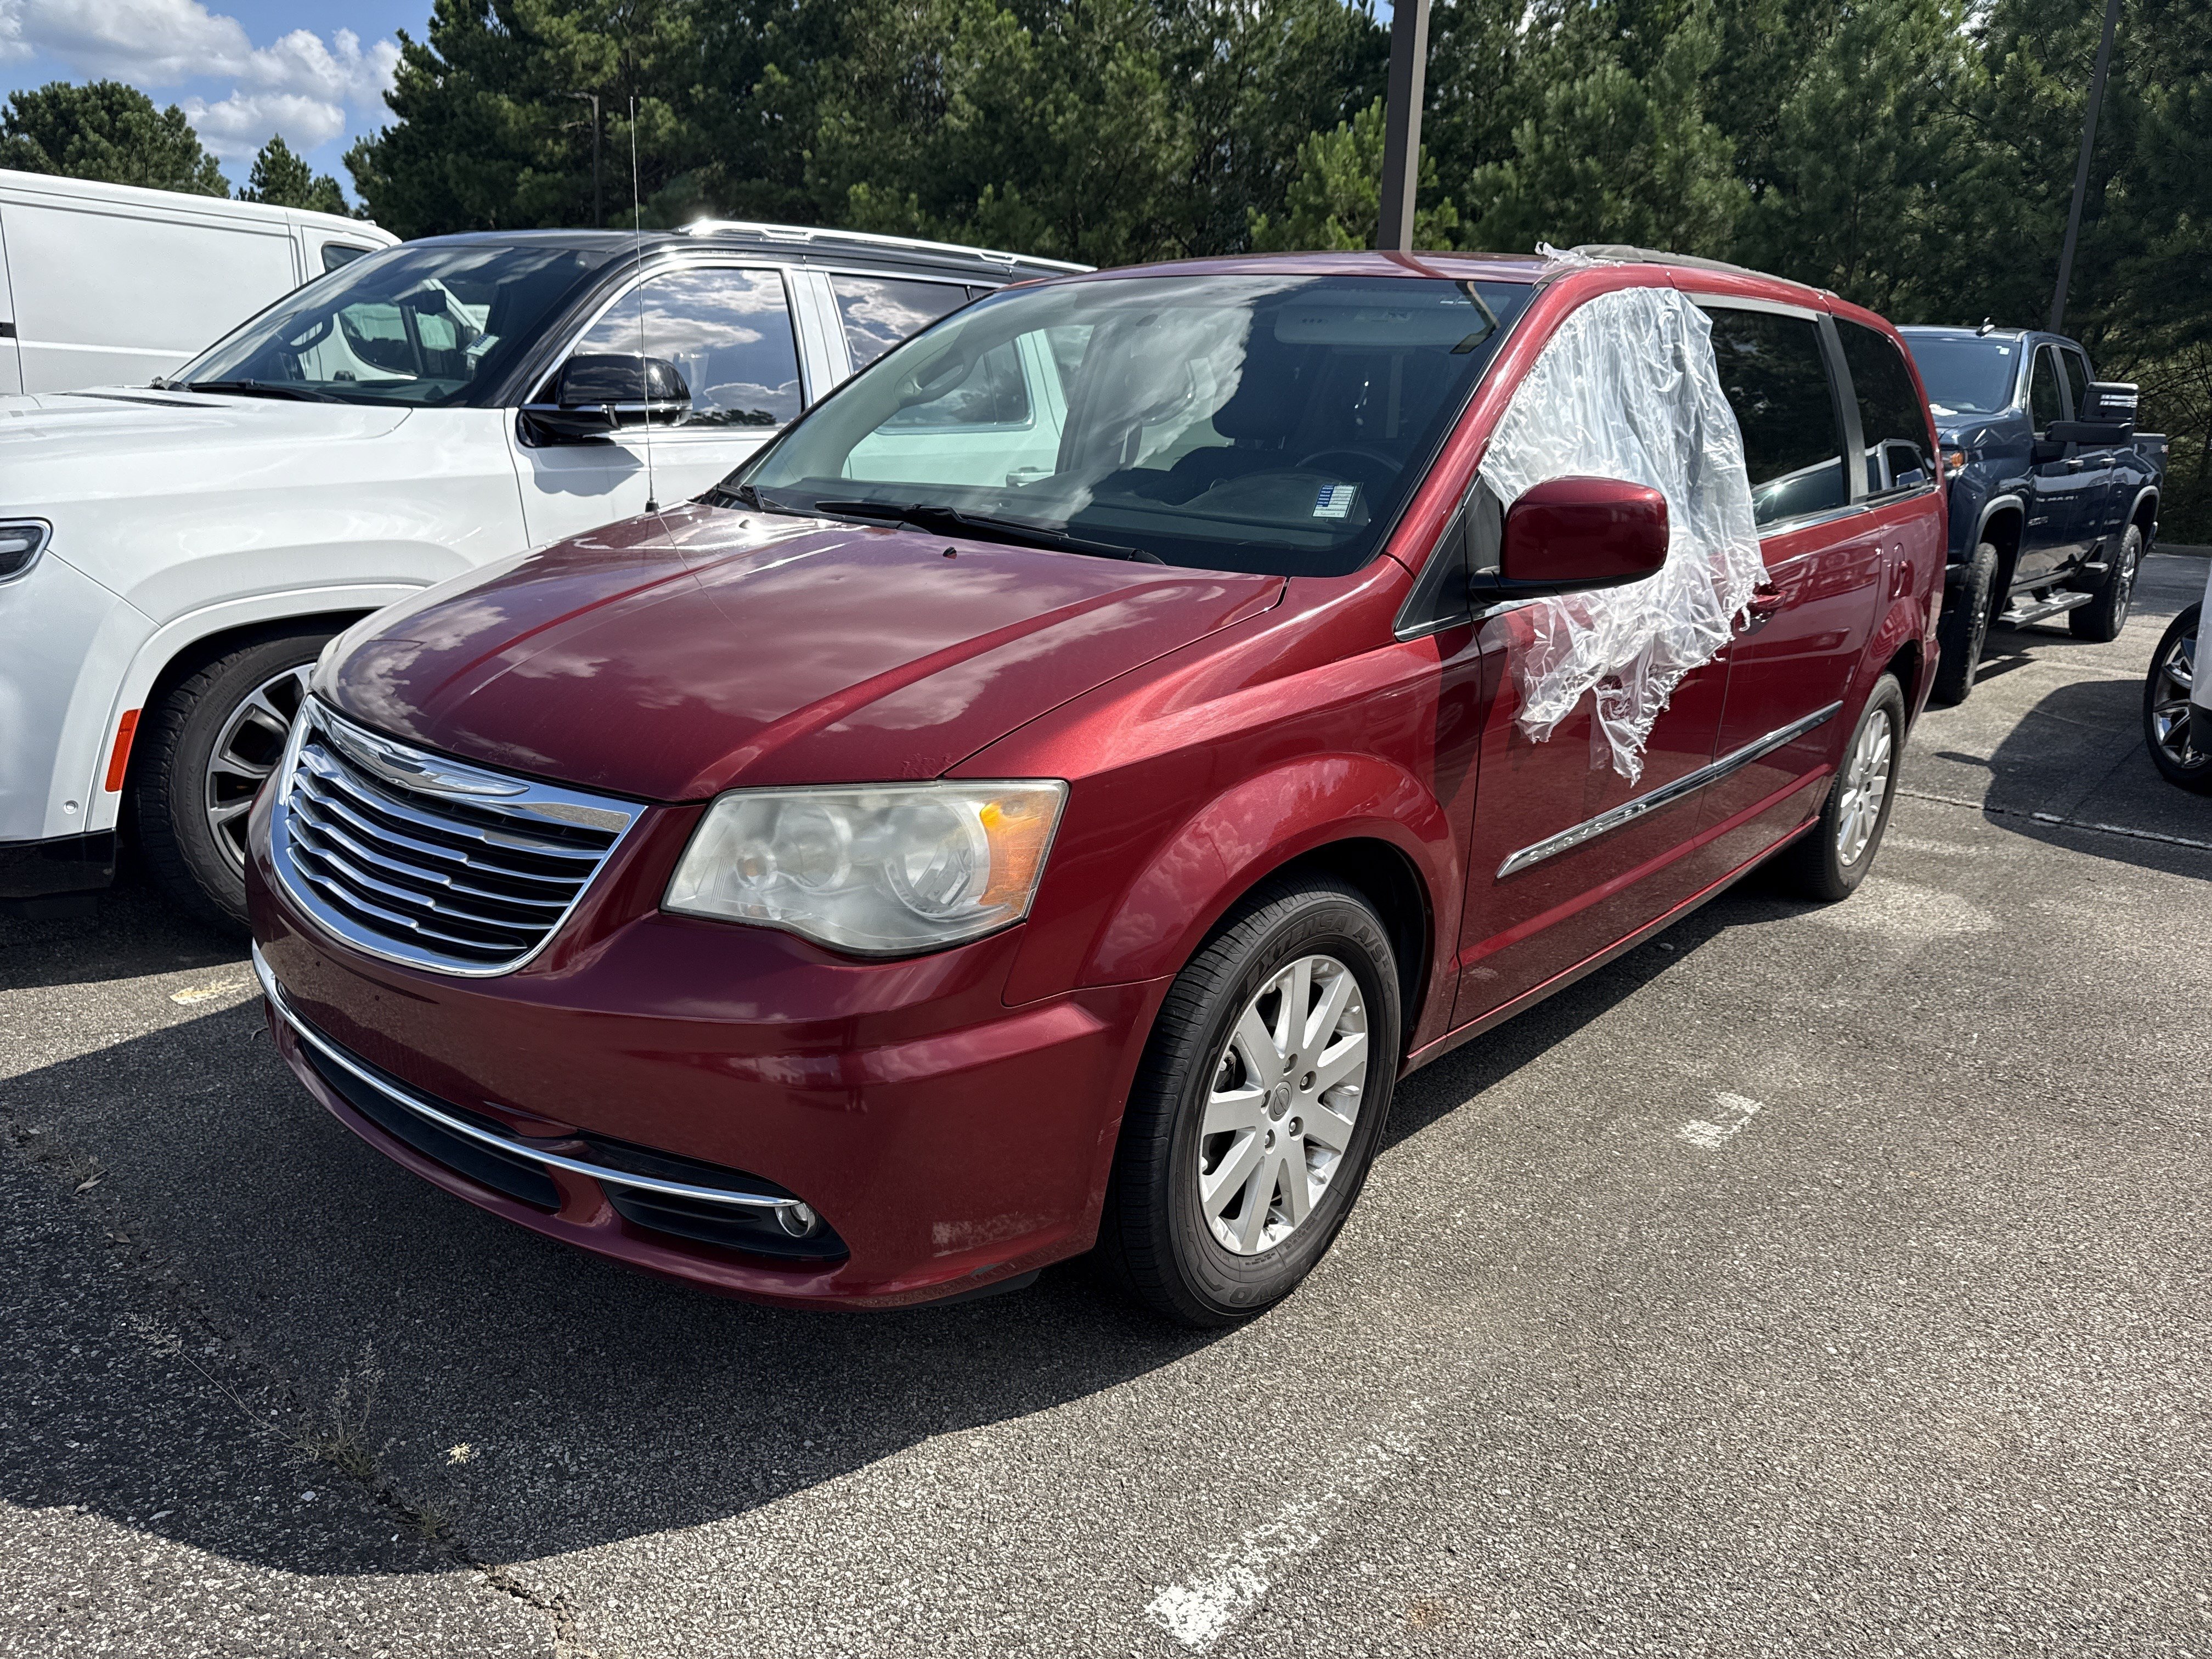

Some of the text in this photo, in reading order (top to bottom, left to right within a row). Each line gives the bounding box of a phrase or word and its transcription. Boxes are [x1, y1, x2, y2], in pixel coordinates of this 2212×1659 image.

[1530, 804, 1646, 861] CHRYSLER
[1246, 914, 1347, 996] EXTENSA
[1230, 1257, 1312, 1304] TOYO
